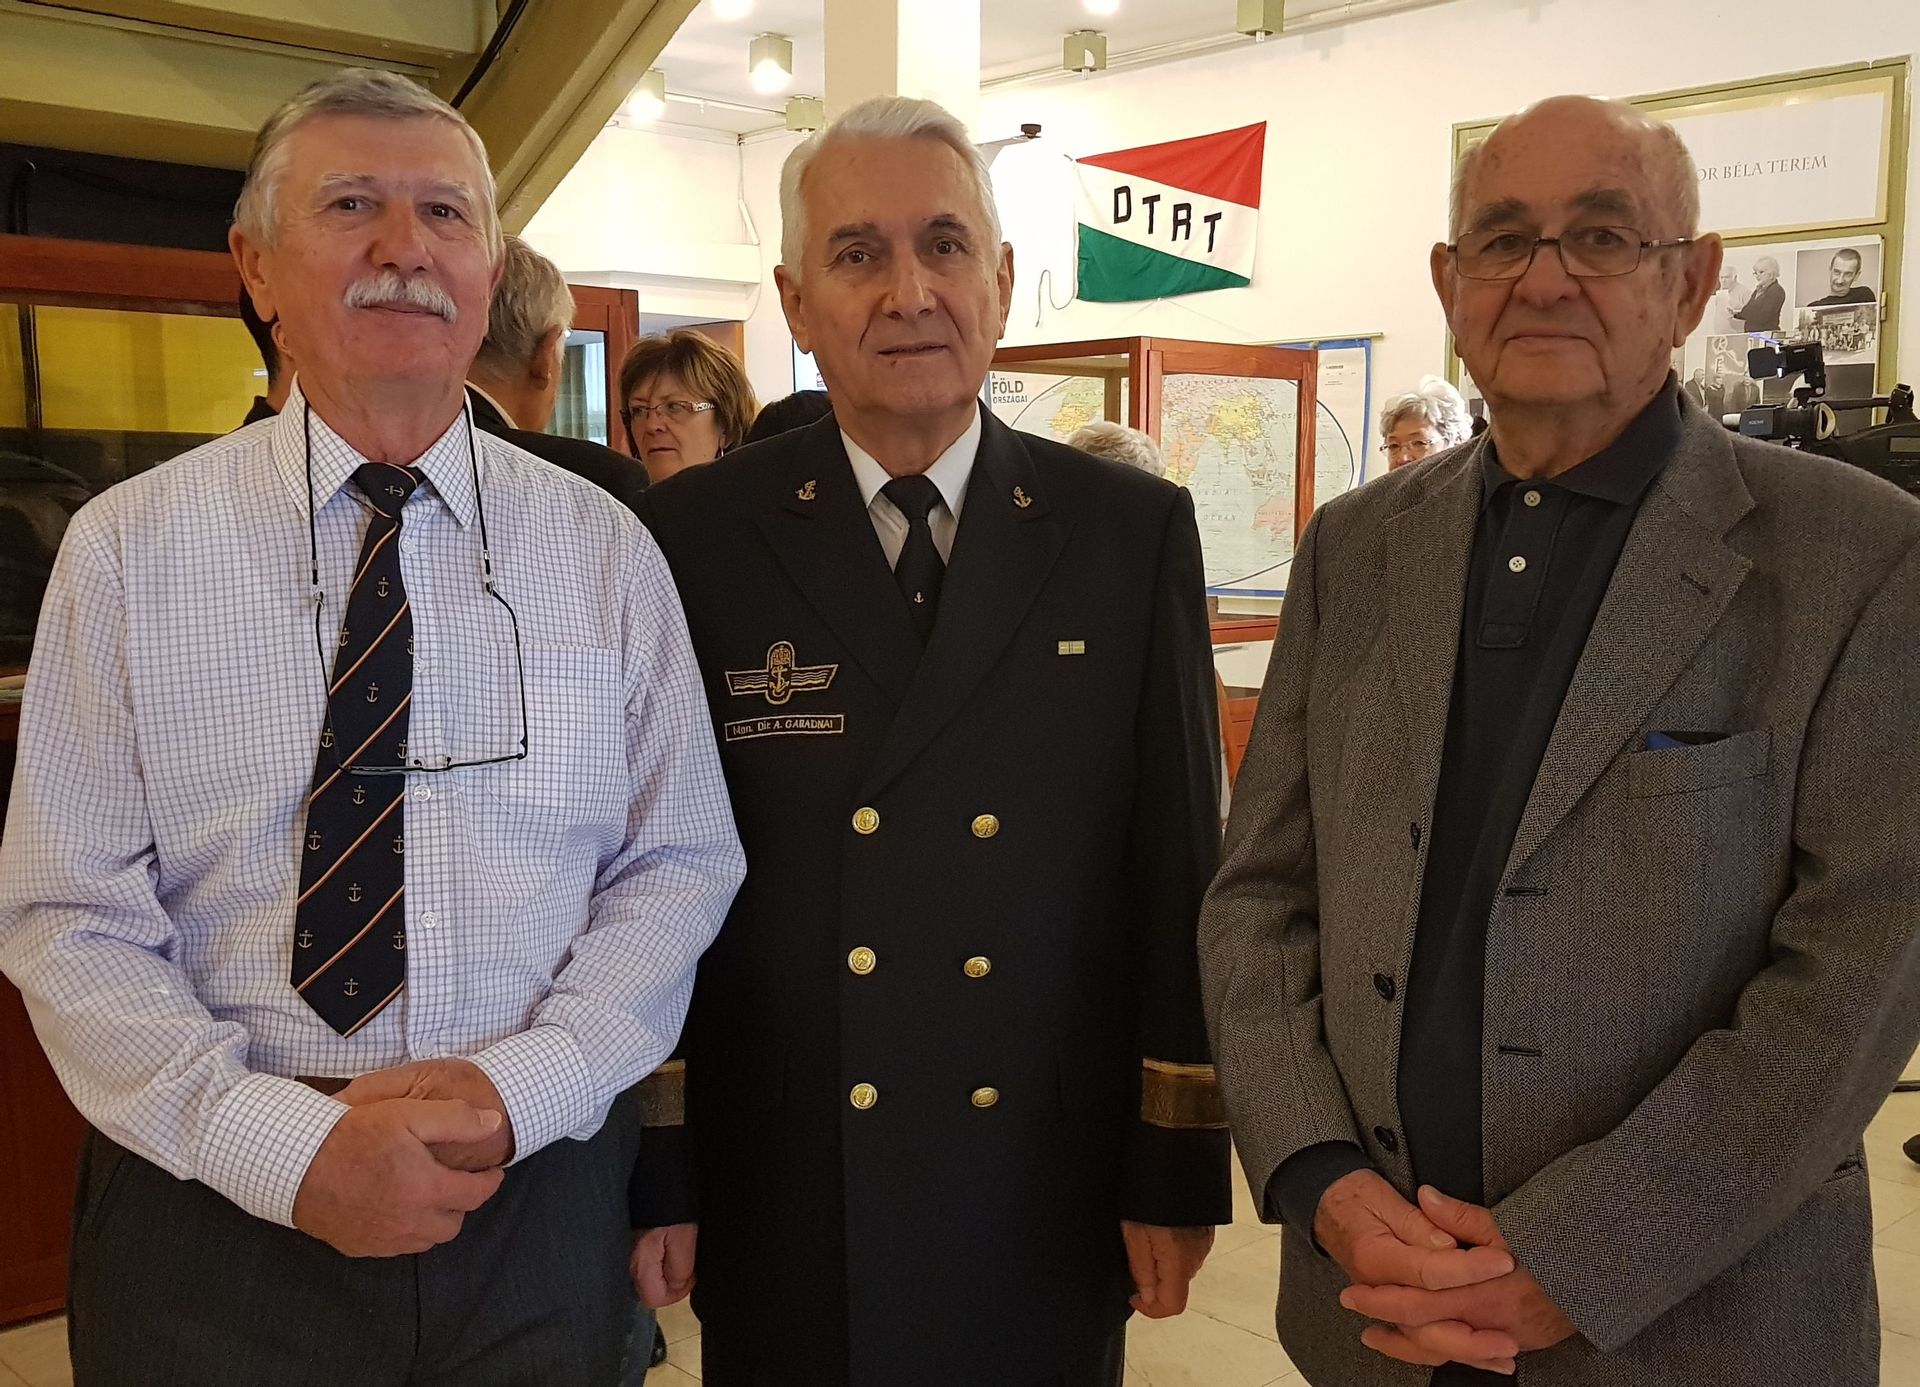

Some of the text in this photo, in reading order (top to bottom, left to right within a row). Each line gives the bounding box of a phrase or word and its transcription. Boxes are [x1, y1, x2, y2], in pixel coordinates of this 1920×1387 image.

[1723, 161, 1762, 179] BÉLA
[1767, 155, 1828, 174] TEREM
[1113, 185, 1222, 253] DTRT
[992, 378, 1024, 395] FÖLD
[992, 395, 1028, 404] ORSZÁGAI
[773, 720, 783, 729] A.
